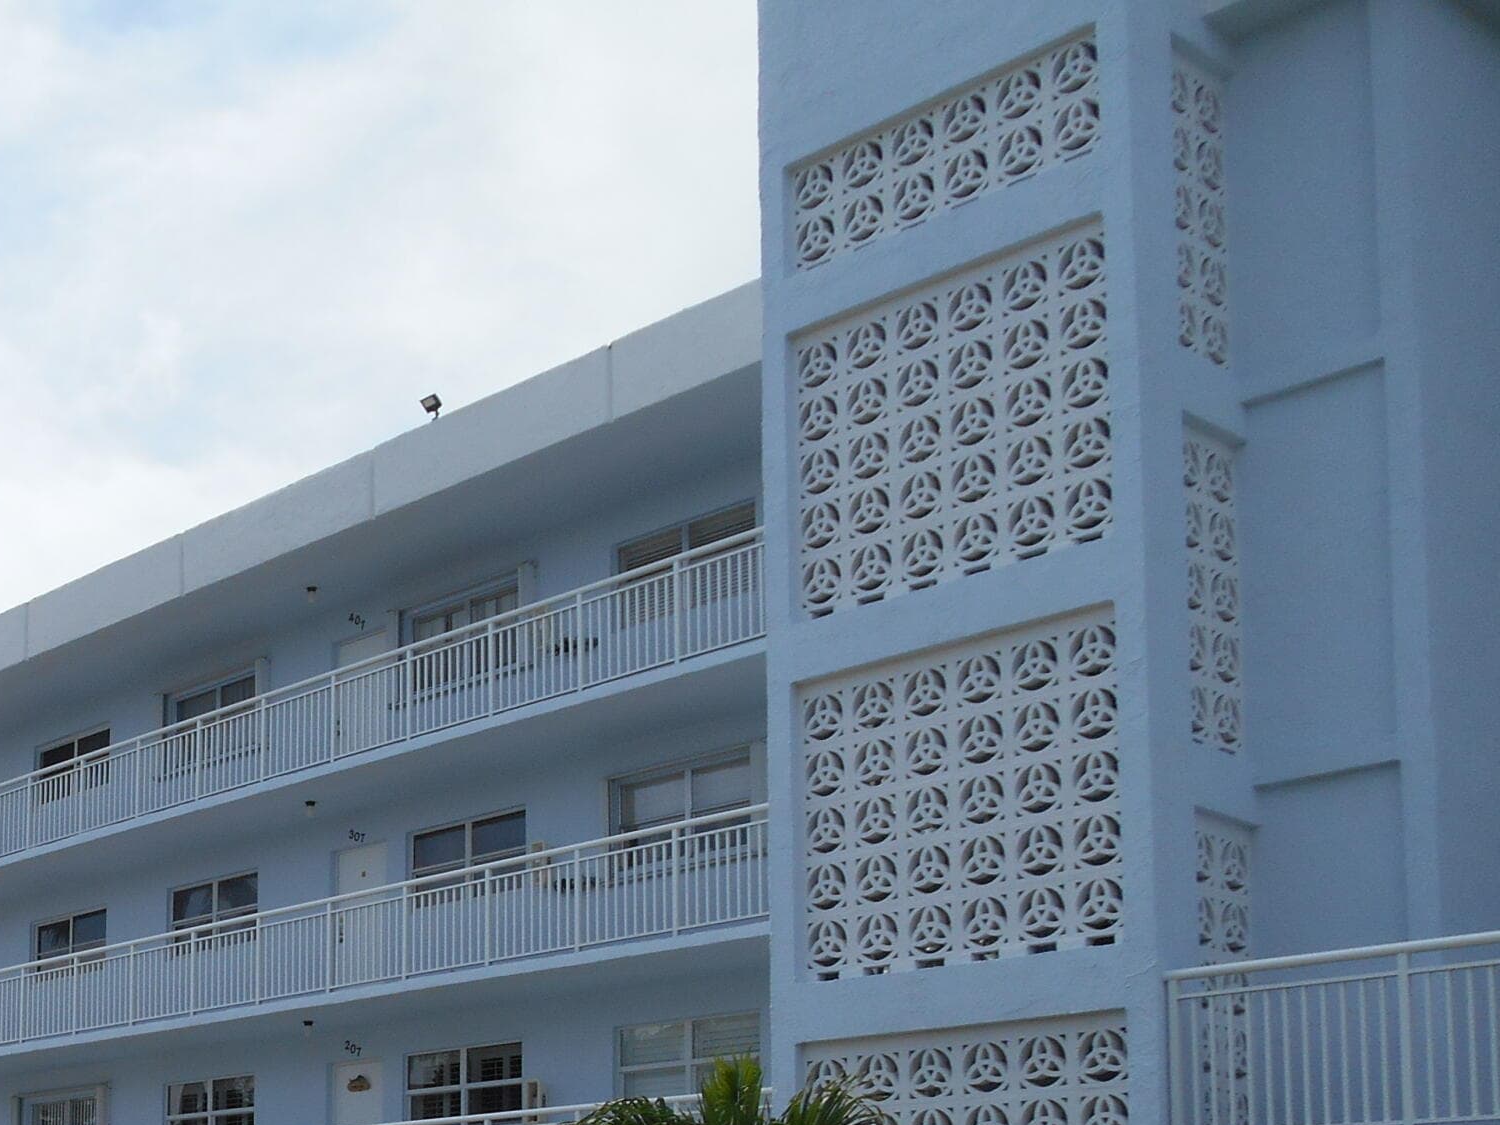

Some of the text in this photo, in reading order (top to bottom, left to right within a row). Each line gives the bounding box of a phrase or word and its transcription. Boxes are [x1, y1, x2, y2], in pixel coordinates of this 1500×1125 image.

[348, 613, 366, 630] 407
[348, 829, 365, 843] 307
[344, 1040, 362, 1057] 207
